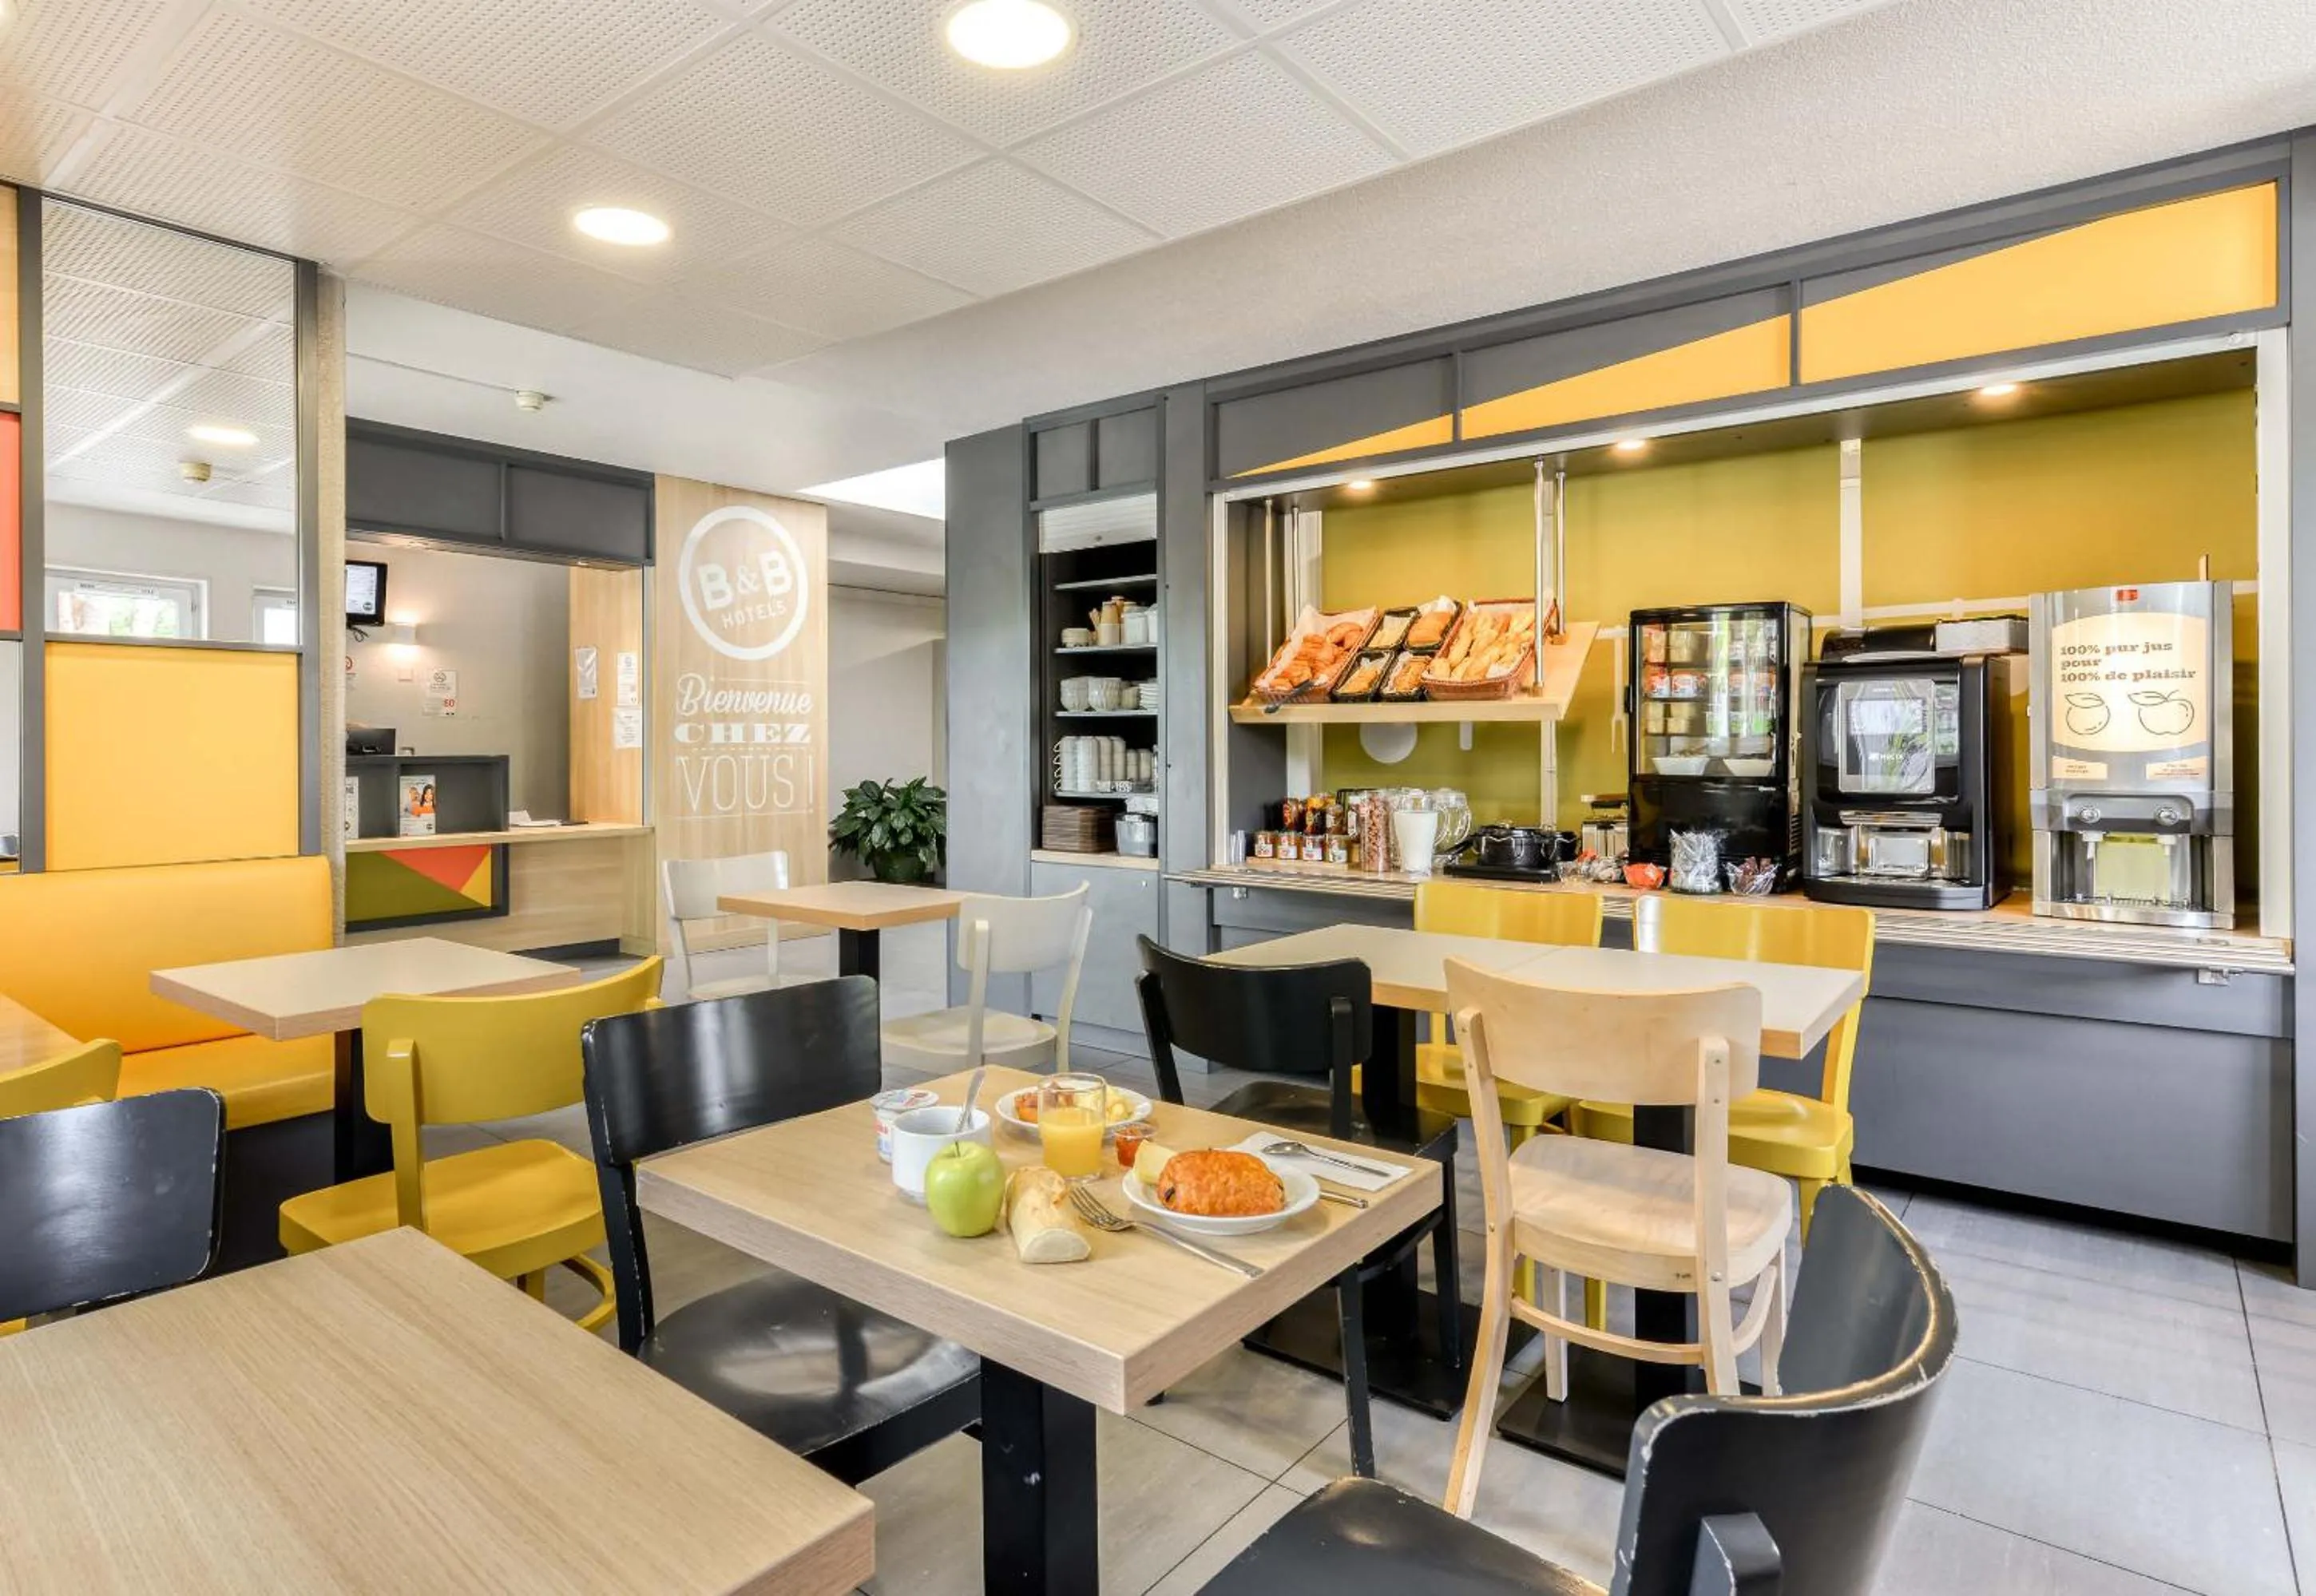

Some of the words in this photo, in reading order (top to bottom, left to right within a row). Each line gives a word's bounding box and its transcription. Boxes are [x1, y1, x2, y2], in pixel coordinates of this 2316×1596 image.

[697, 550, 793, 612] B&B
[720, 599, 787, 630] HOTELS
[2060, 644, 2100, 656] 100%
[2104, 644, 2140, 656] pur
[2142, 641, 2173, 655] jus
[2060, 658, 2102, 671] pour
[2060, 671, 2100, 683] 100%
[2104, 670, 2128, 680] de
[2132, 667, 2197, 683] plaisir
[676, 672, 814, 717] Bienvenue
[674, 722, 811, 743] CHEZ
